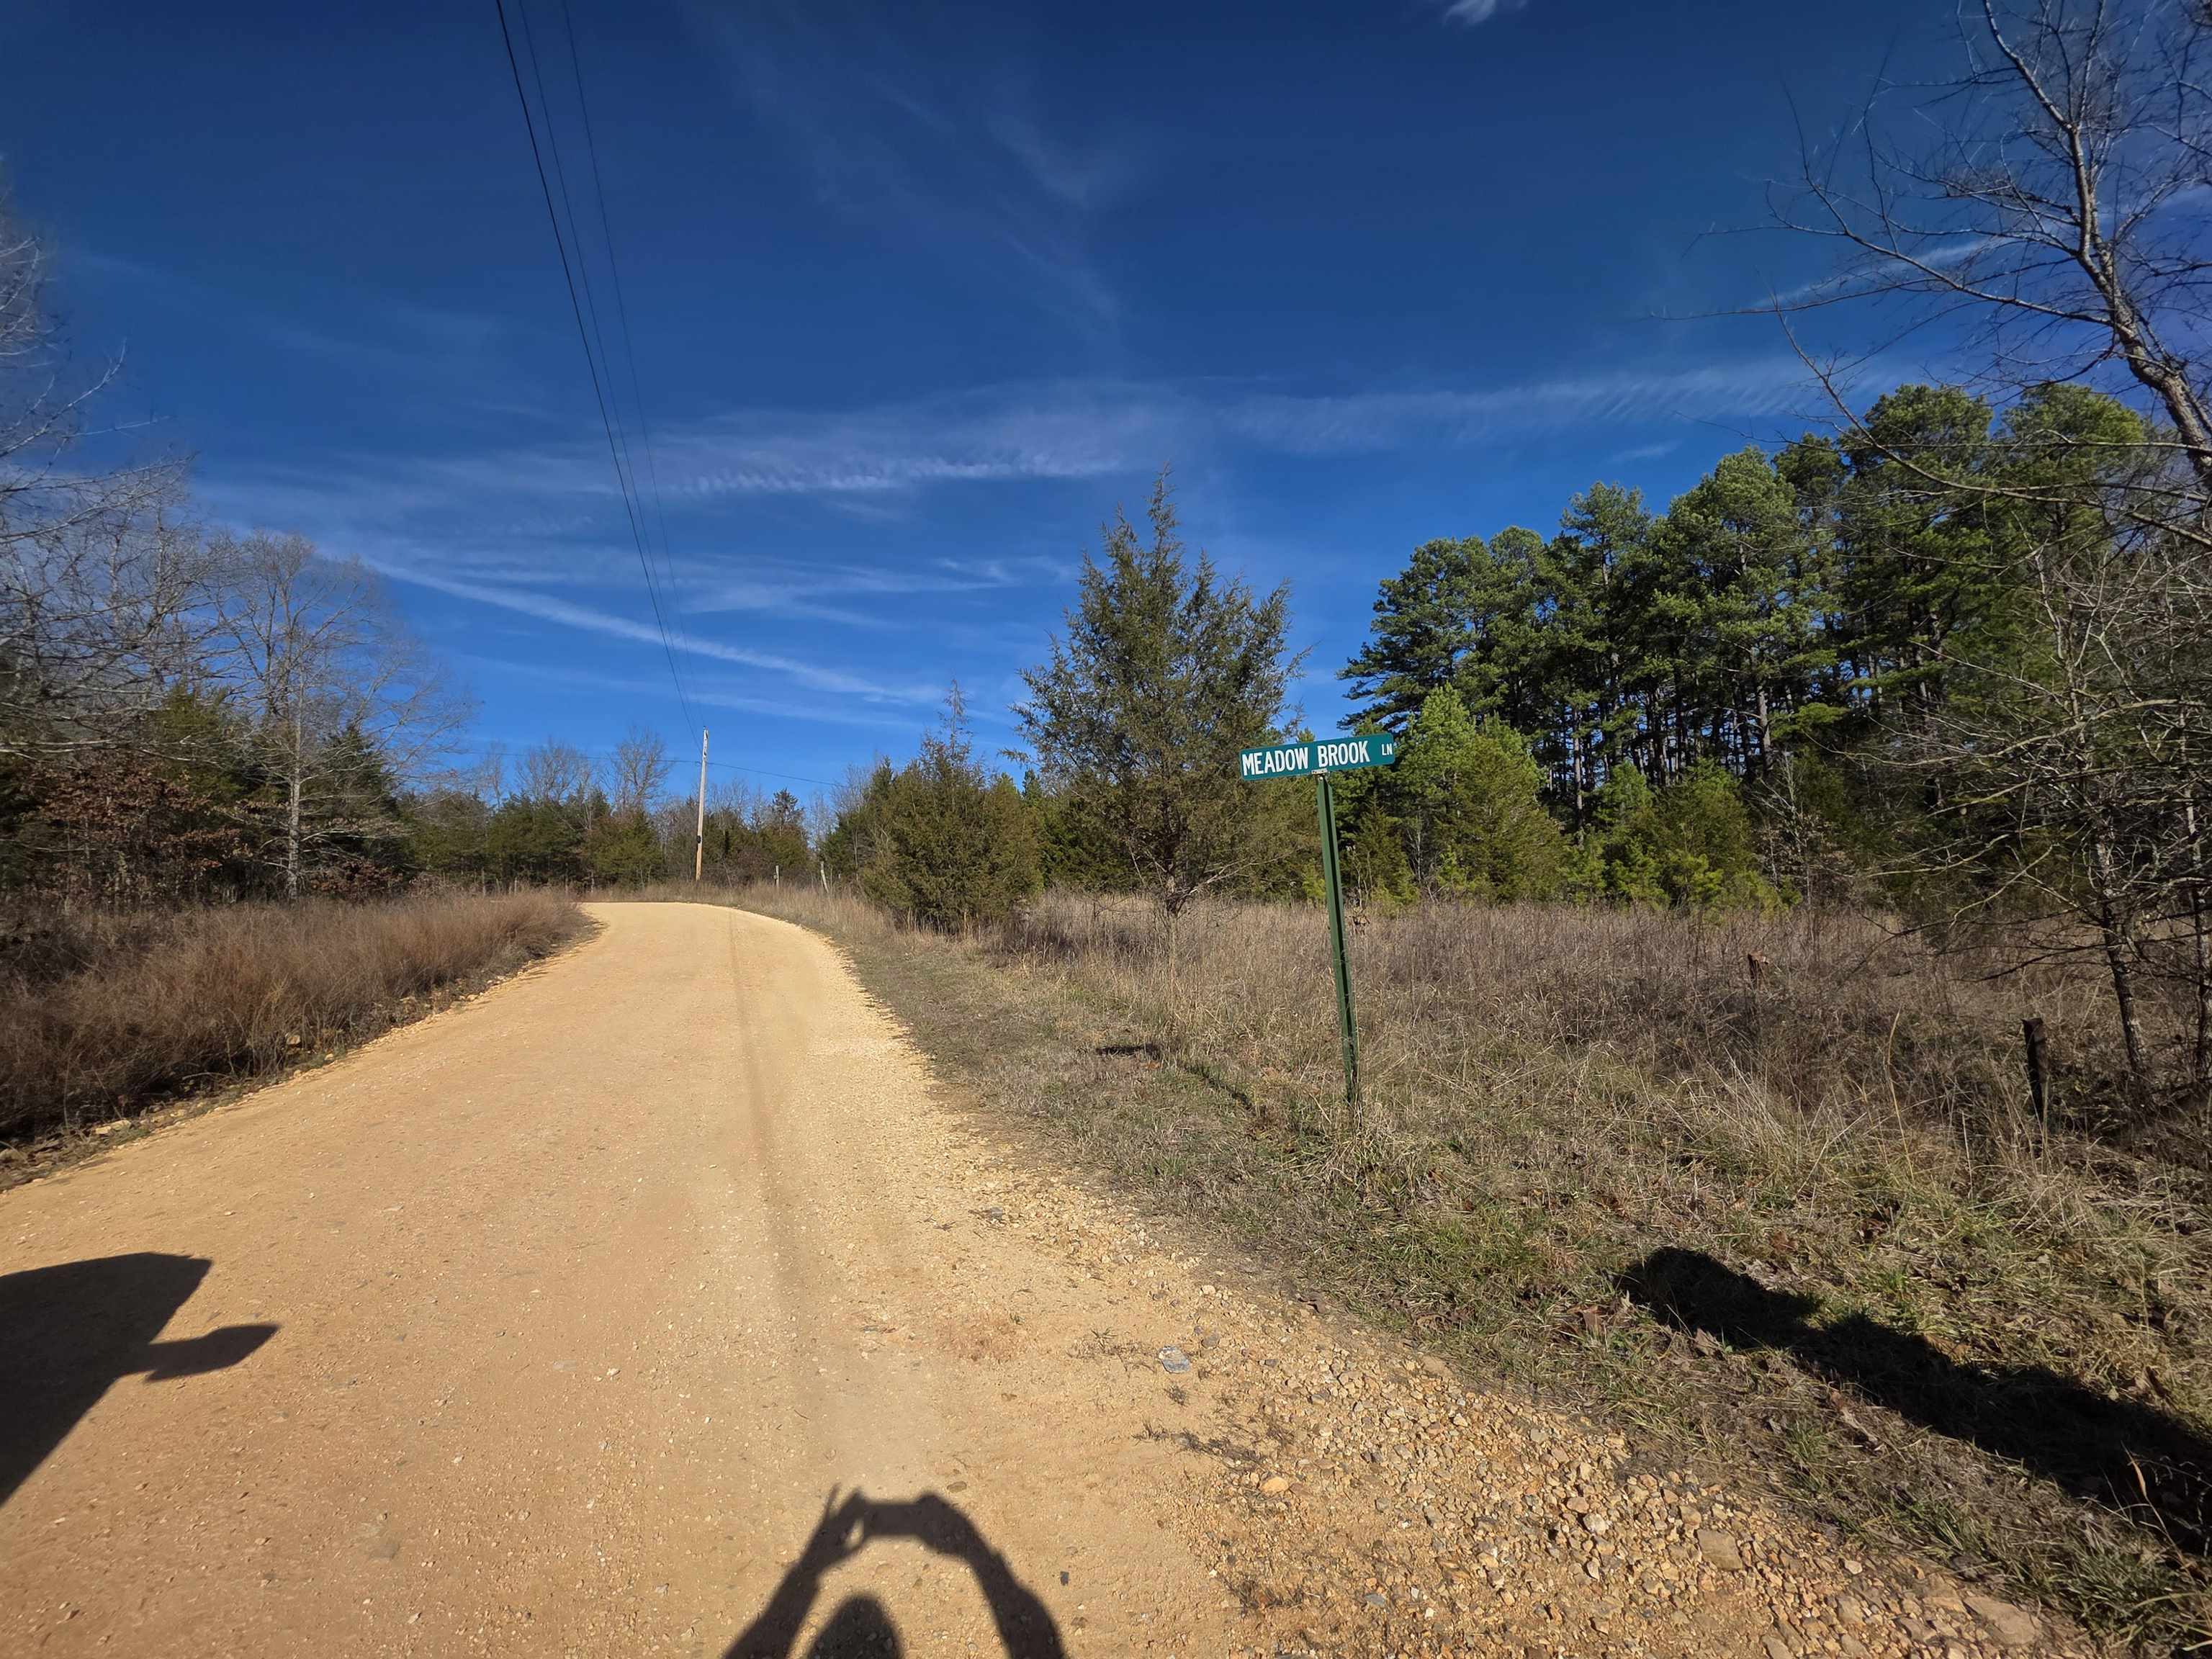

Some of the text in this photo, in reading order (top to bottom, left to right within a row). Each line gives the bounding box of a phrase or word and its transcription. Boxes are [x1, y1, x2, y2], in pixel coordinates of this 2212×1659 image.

[1242, 740, 1393, 775] MEADOW BROOK LN
